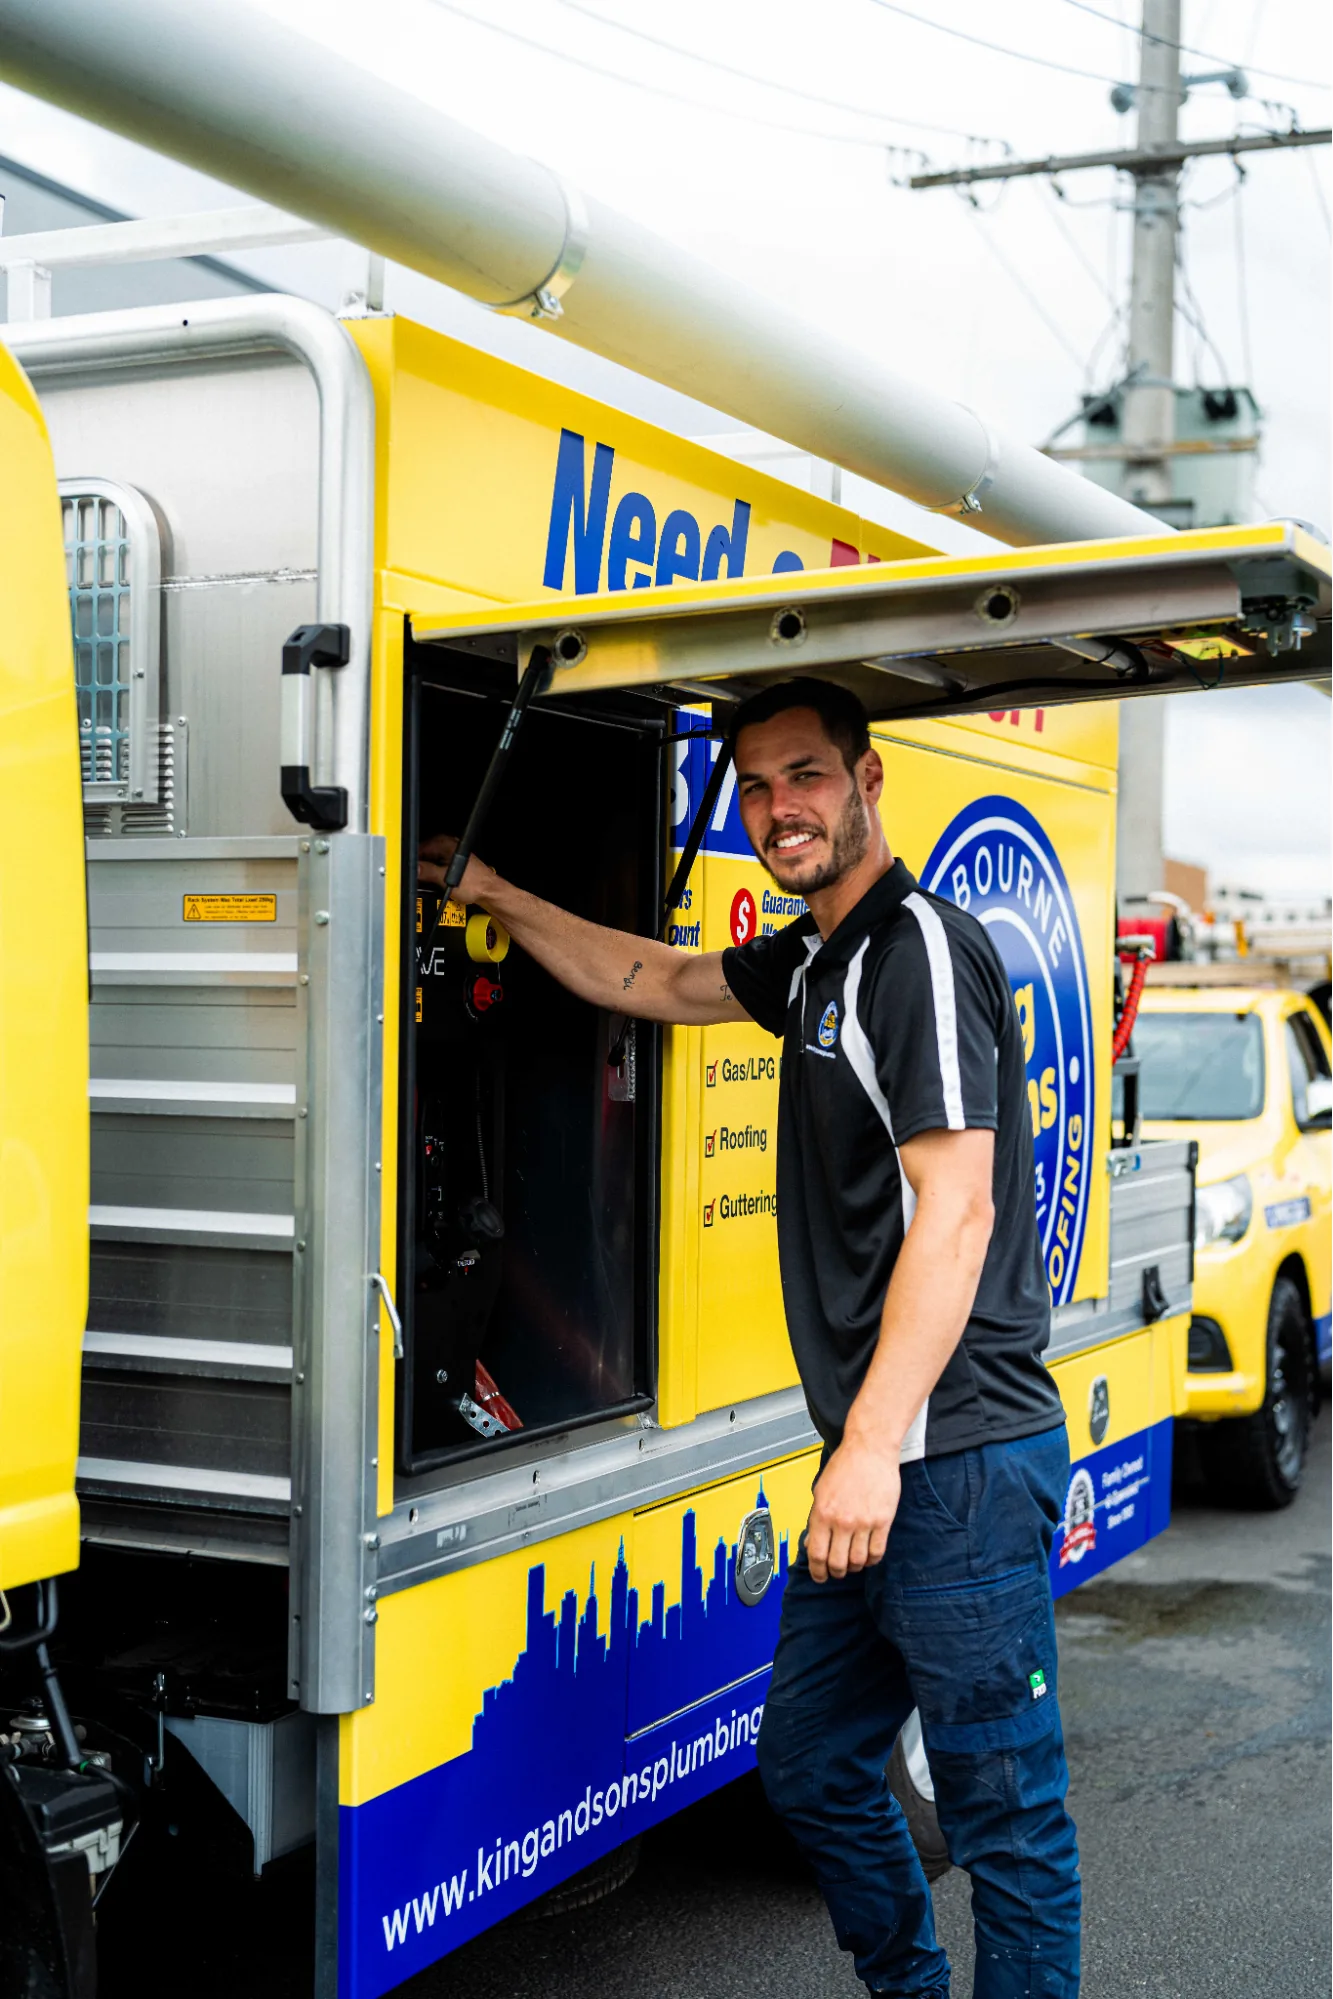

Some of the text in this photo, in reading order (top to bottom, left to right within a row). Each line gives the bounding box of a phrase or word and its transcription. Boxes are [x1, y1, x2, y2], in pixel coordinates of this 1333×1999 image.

[543, 428, 751, 595] Need
[722, 1057, 775, 1082] Gas/LPG
[720, 1125, 767, 1152] Roofing
[720, 1190, 777, 1219] Guttering
[1048, 1114, 1083, 1308] OFING
[382, 1703, 765, 1952] www.kingandsonsplumbing
